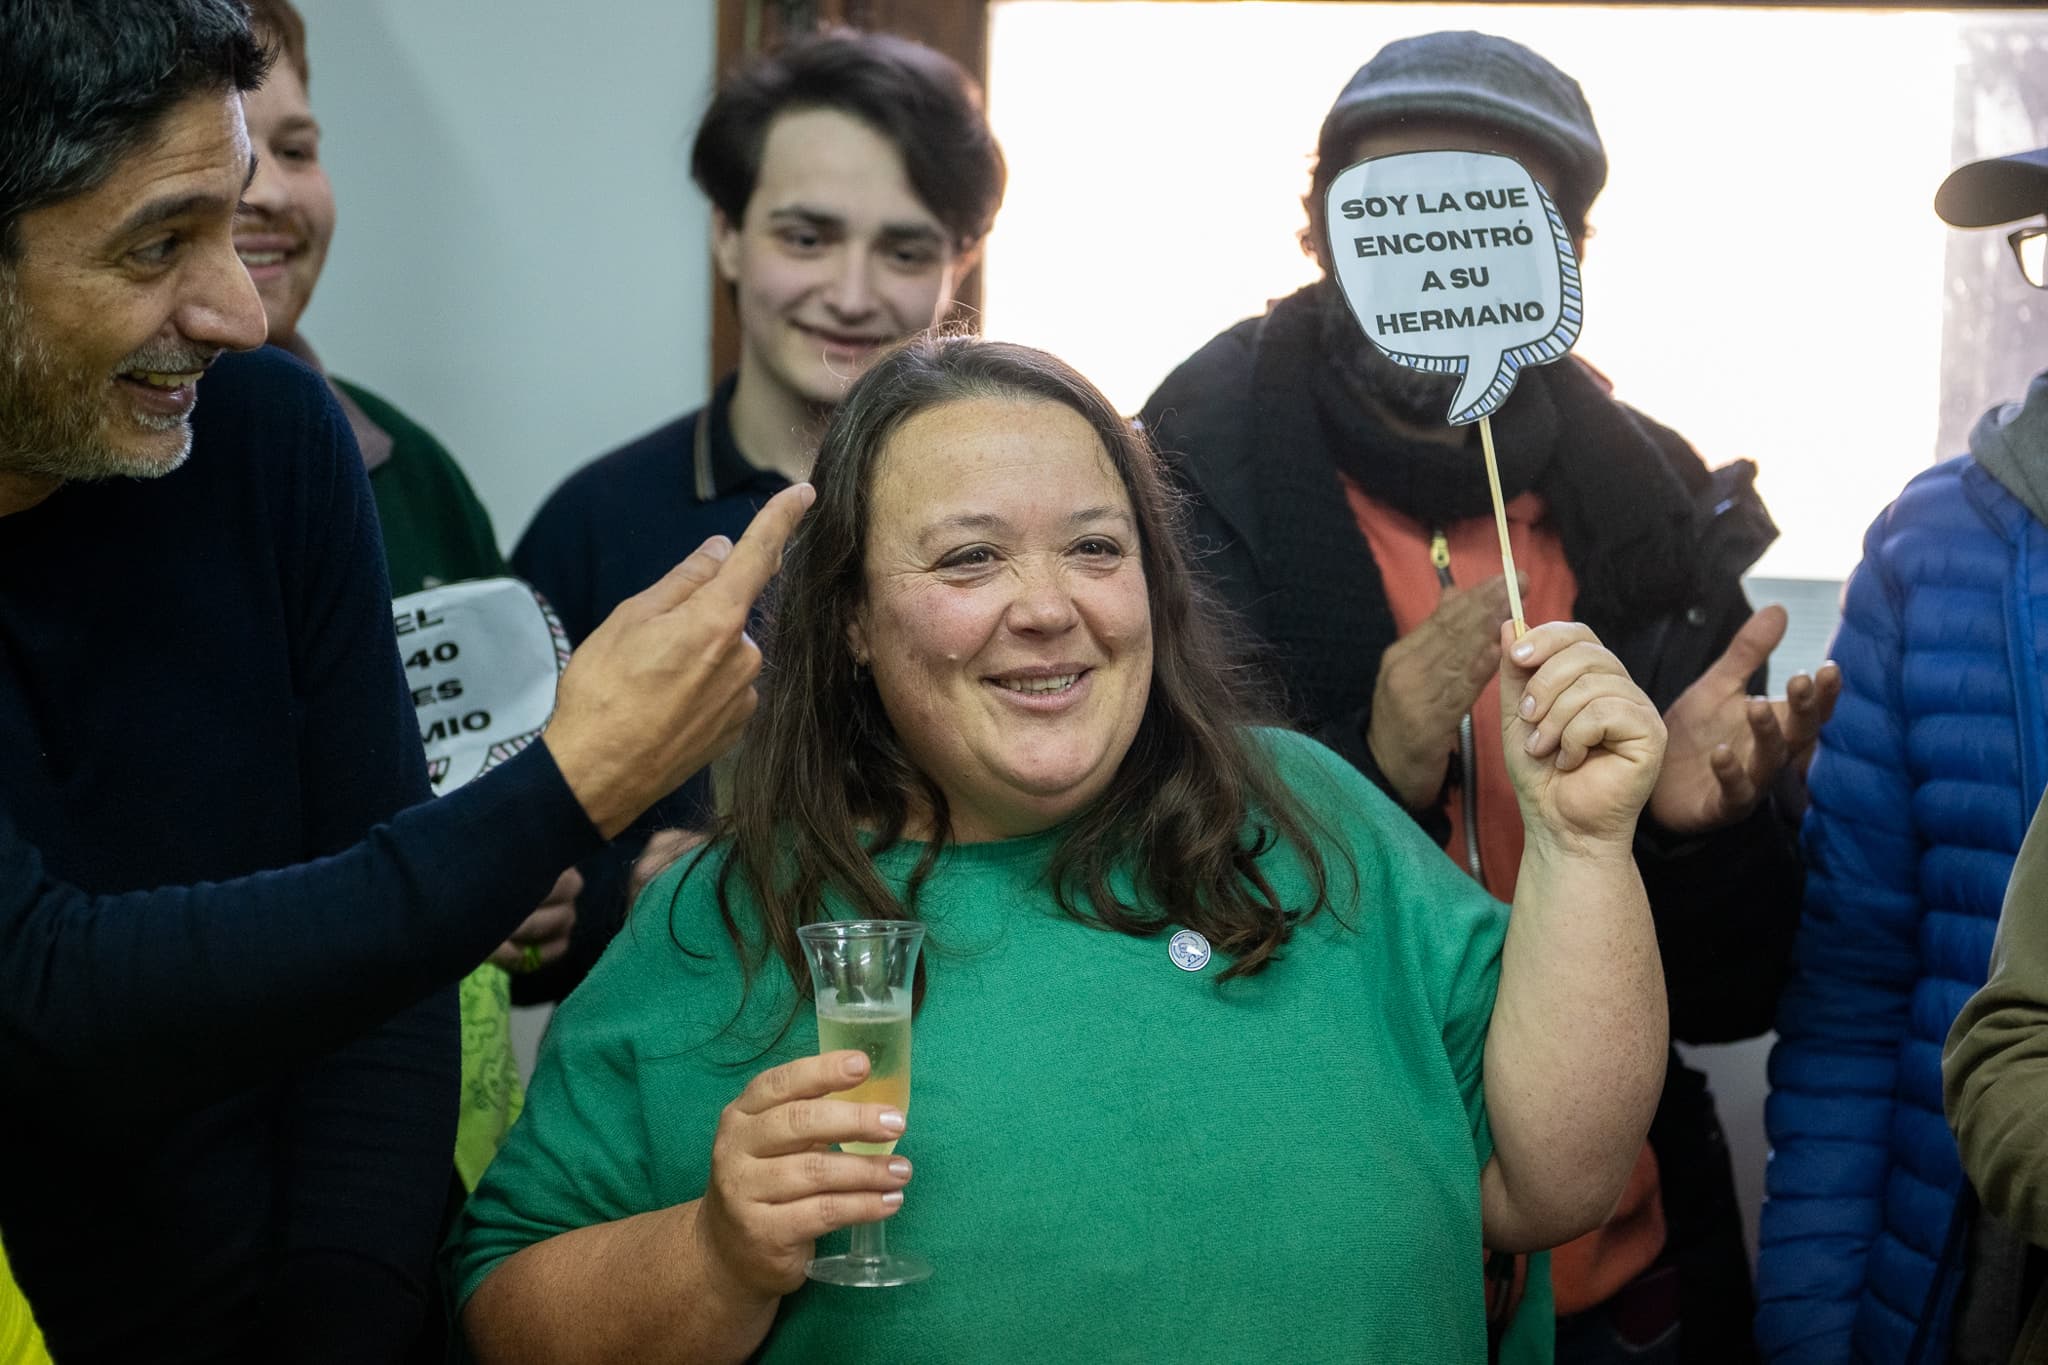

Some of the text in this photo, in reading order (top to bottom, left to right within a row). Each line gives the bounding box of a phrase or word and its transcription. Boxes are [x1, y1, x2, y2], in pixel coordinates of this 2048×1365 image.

[1341, 187, 1529, 219] SOY LA QUE
[1354, 219, 1533, 258] ENCONTRÓ
[1421, 266, 1489, 292] A SU
[1376, 301, 1544, 335] HERMANO
[394, 608, 444, 637] EL
[406, 641, 460, 671] 40
